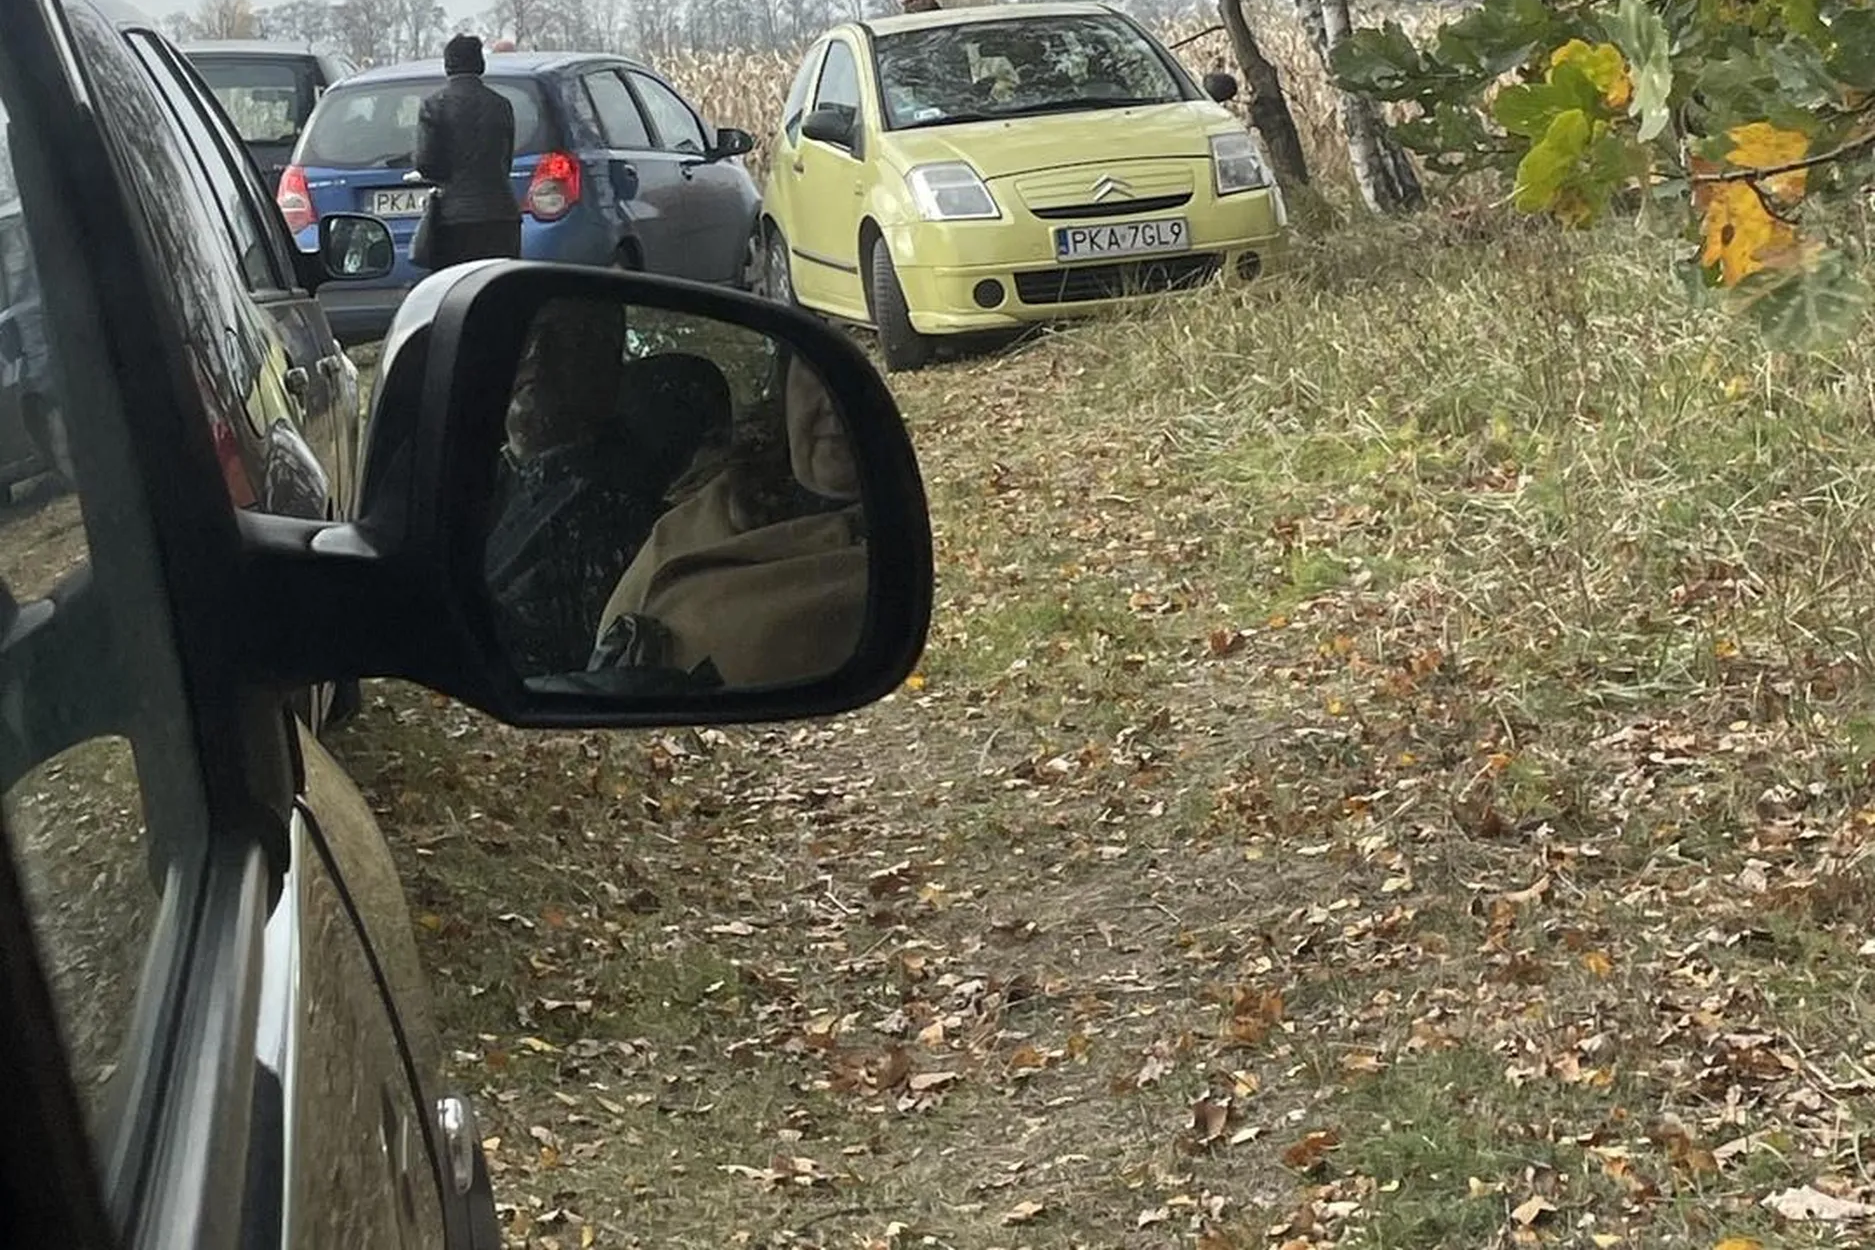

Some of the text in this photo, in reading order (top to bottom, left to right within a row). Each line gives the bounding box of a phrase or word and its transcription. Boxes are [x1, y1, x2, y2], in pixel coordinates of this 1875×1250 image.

[377, 193, 416, 211] PKA
[1071, 222, 1182, 253] PKA 7GL9
